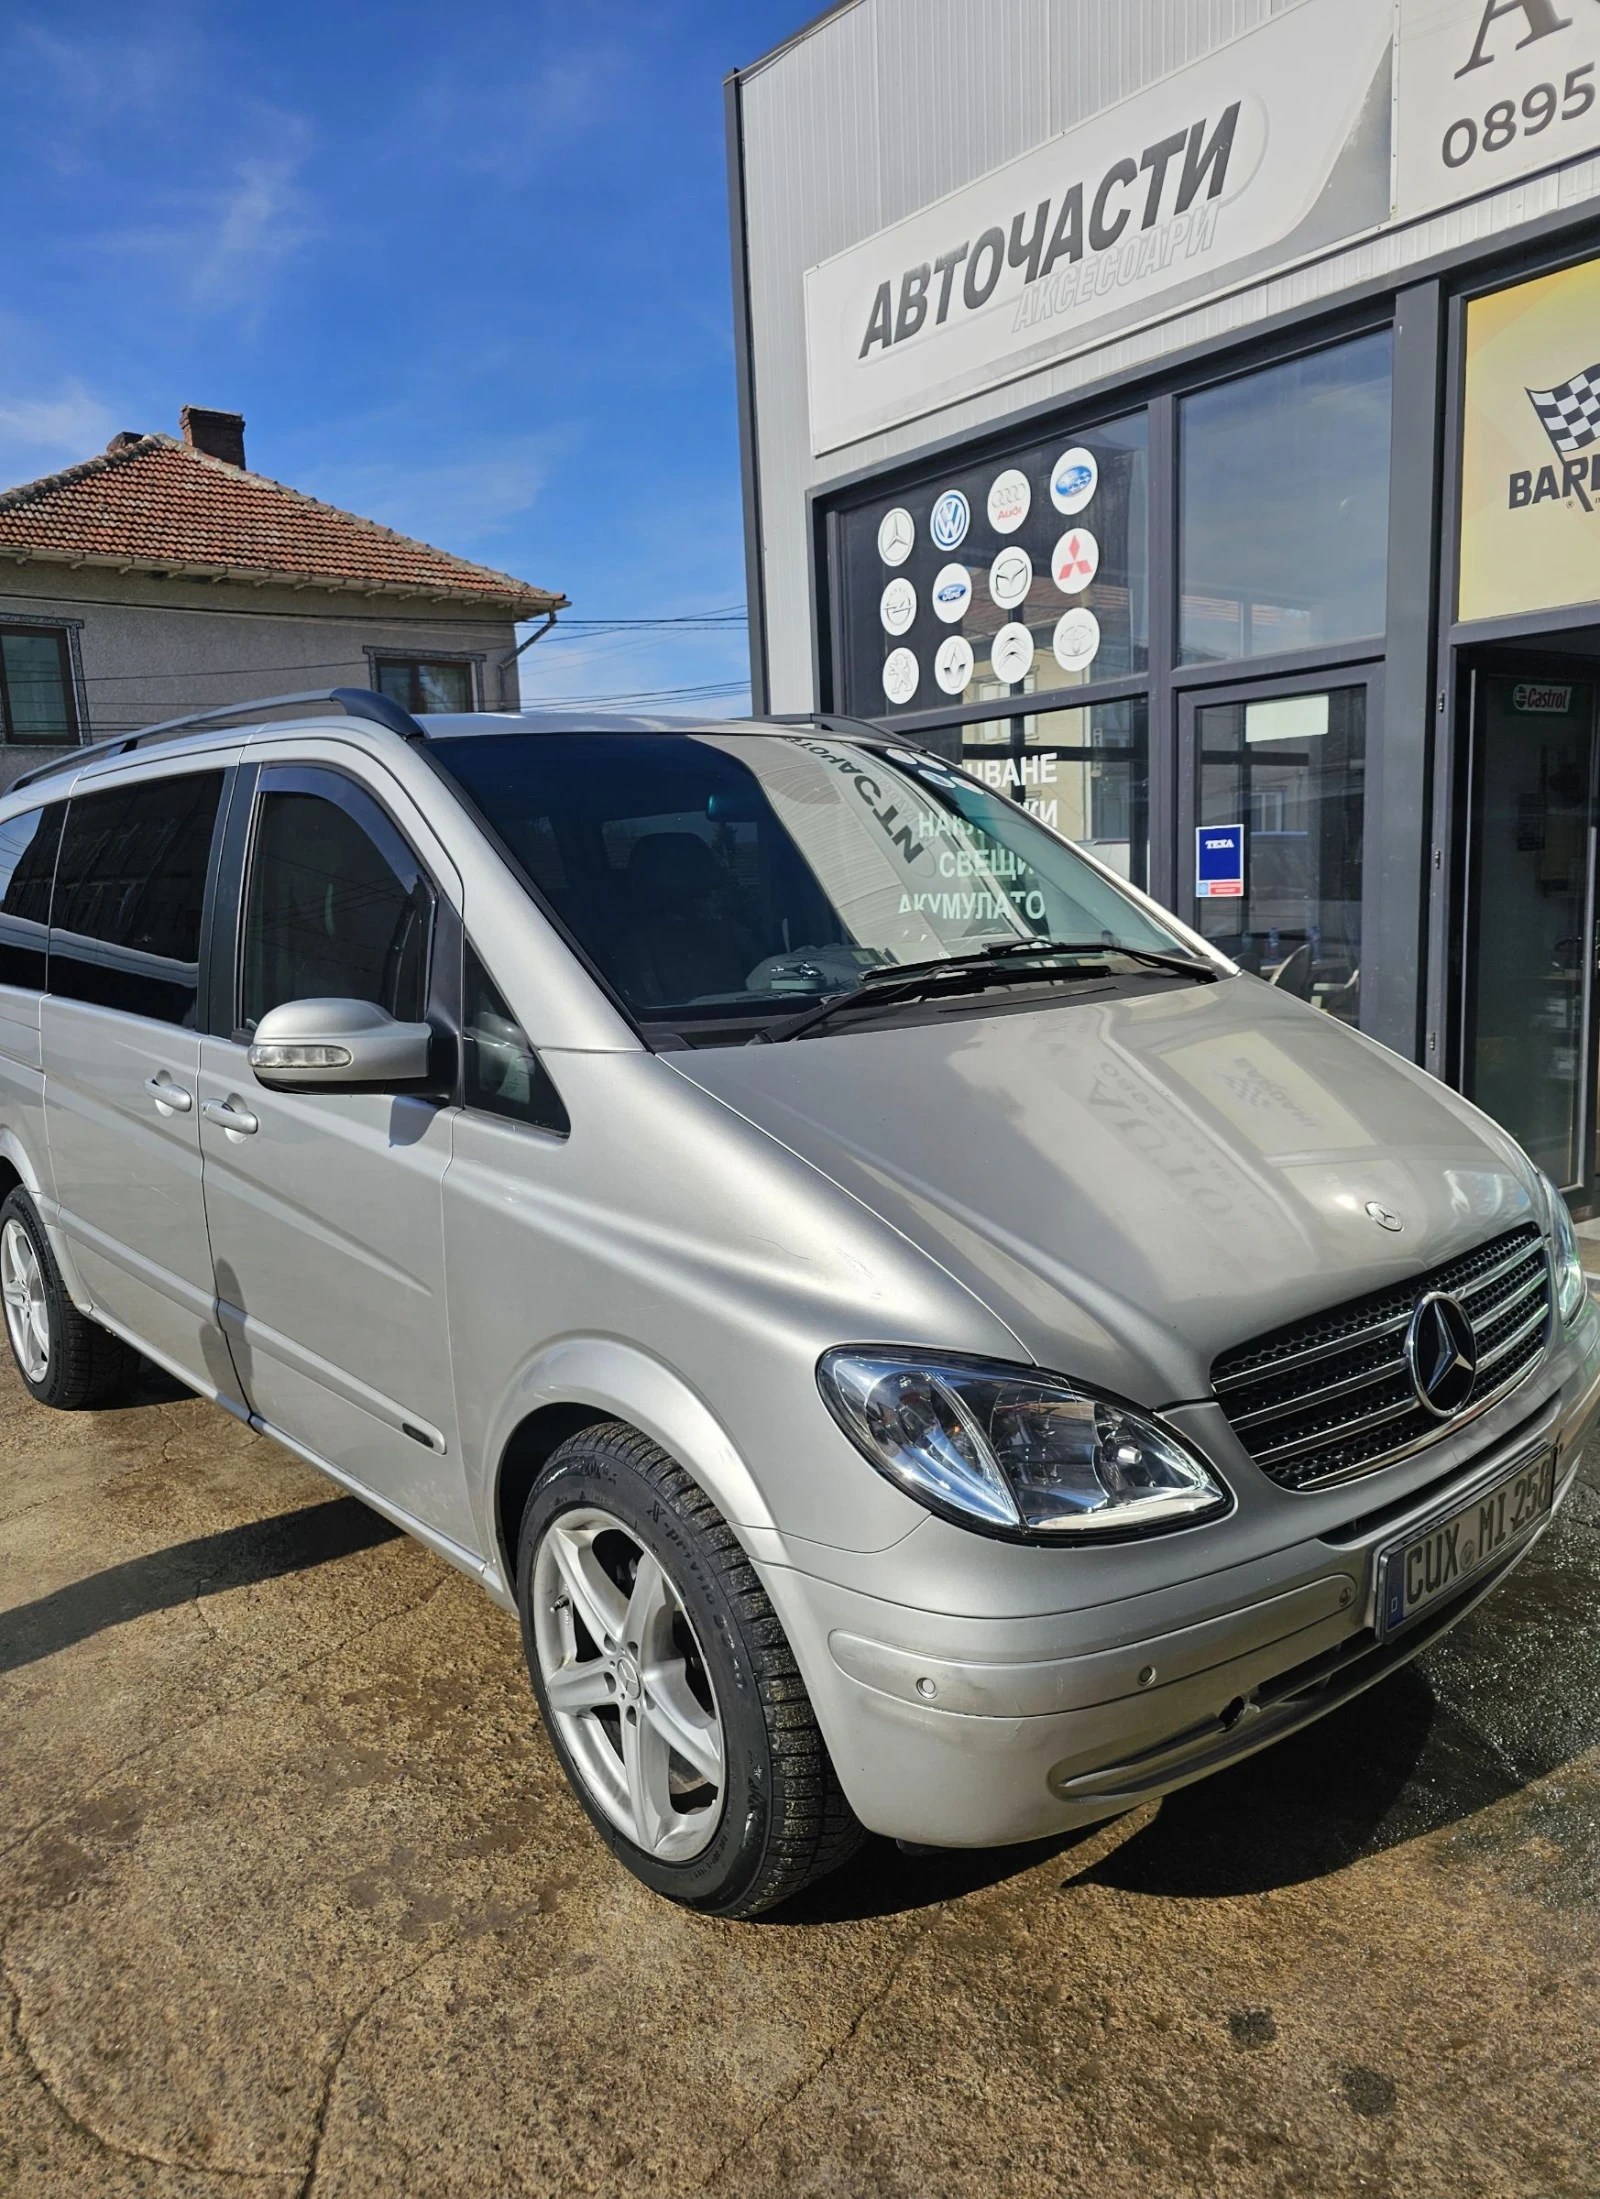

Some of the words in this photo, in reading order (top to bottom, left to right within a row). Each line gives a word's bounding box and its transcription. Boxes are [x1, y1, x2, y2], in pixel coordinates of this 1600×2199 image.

[1441, 61, 1596, 169] 0895
[857, 100, 1242, 360] АВТОЧАСТИ
[1011, 204, 1220, 333] АКСЕСОАРИ
[1527, 687, 1567, 709] Castrol
[1205, 838, 1235, 849] TEXA
[1406, 1522, 1460, 1605] CUX
[1478, 1492, 1507, 1559] MI
